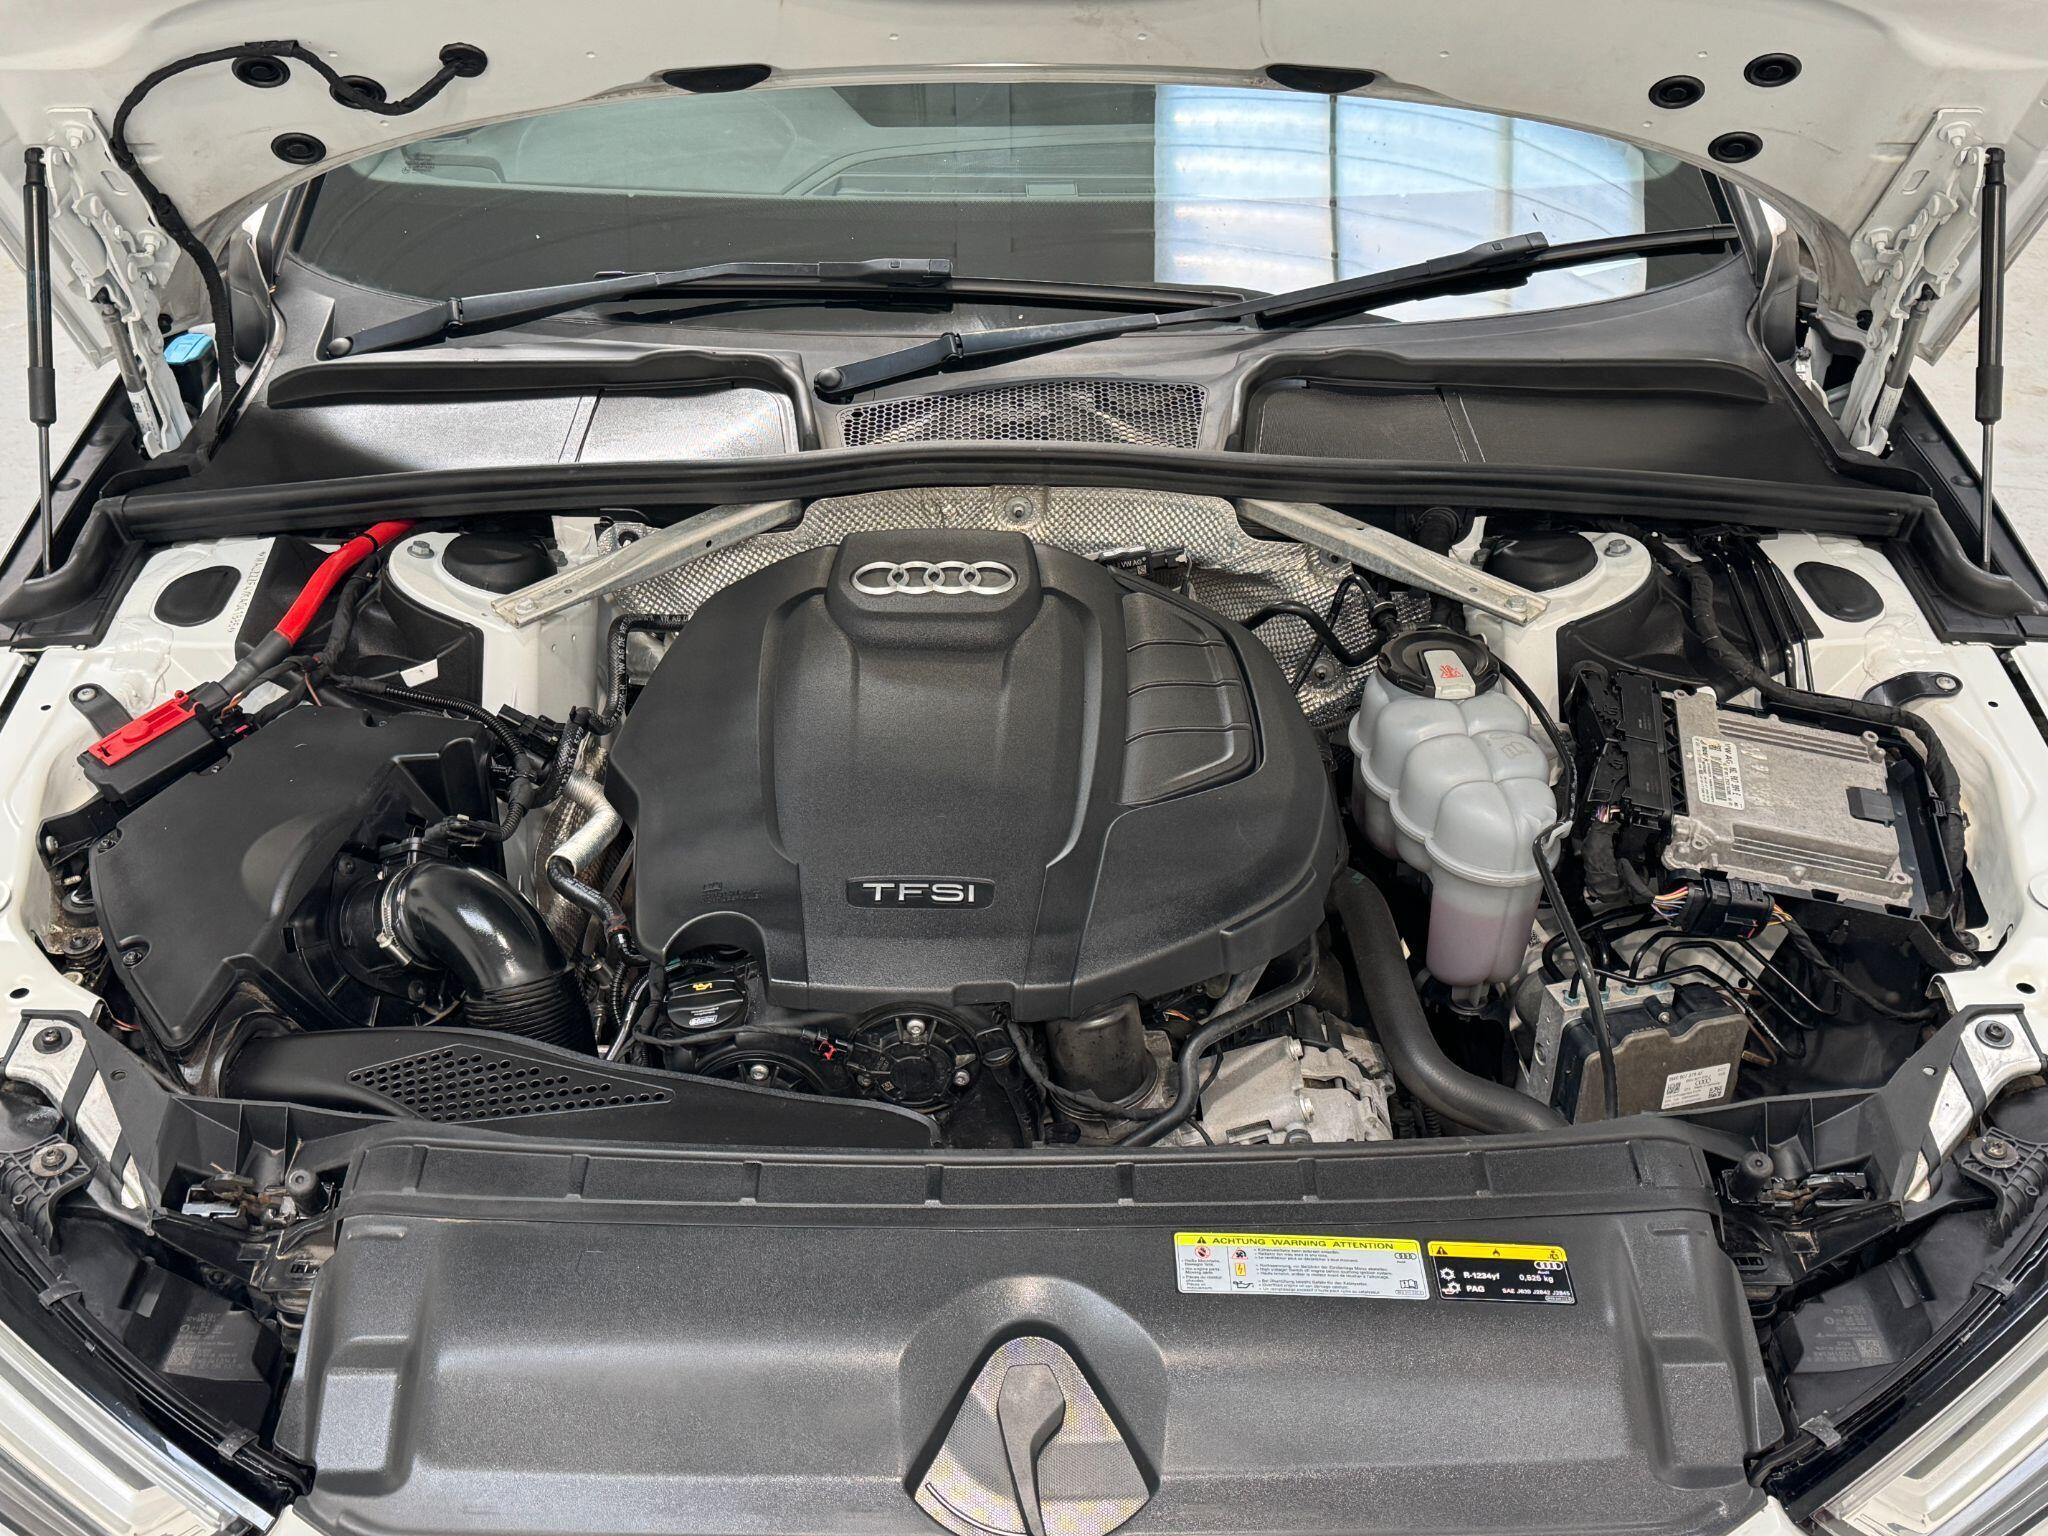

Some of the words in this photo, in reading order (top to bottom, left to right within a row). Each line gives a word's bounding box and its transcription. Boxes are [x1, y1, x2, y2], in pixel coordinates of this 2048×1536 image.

[1133, 558, 1143, 566] AG
[862, 882, 975, 903] TFSI
[1212, 1237, 1266, 1246] ACHTUNG
[1271, 1238, 1327, 1247] WARNING
[1332, 1240, 1394, 1249] ATTENTION
[1462, 1271, 1501, 1281] R-1234yf
[1518, 1274, 1543, 1282] 0,525
[1543, 1275, 1554, 1284] kg
[1466, 1285, 1486, 1293] PAG
